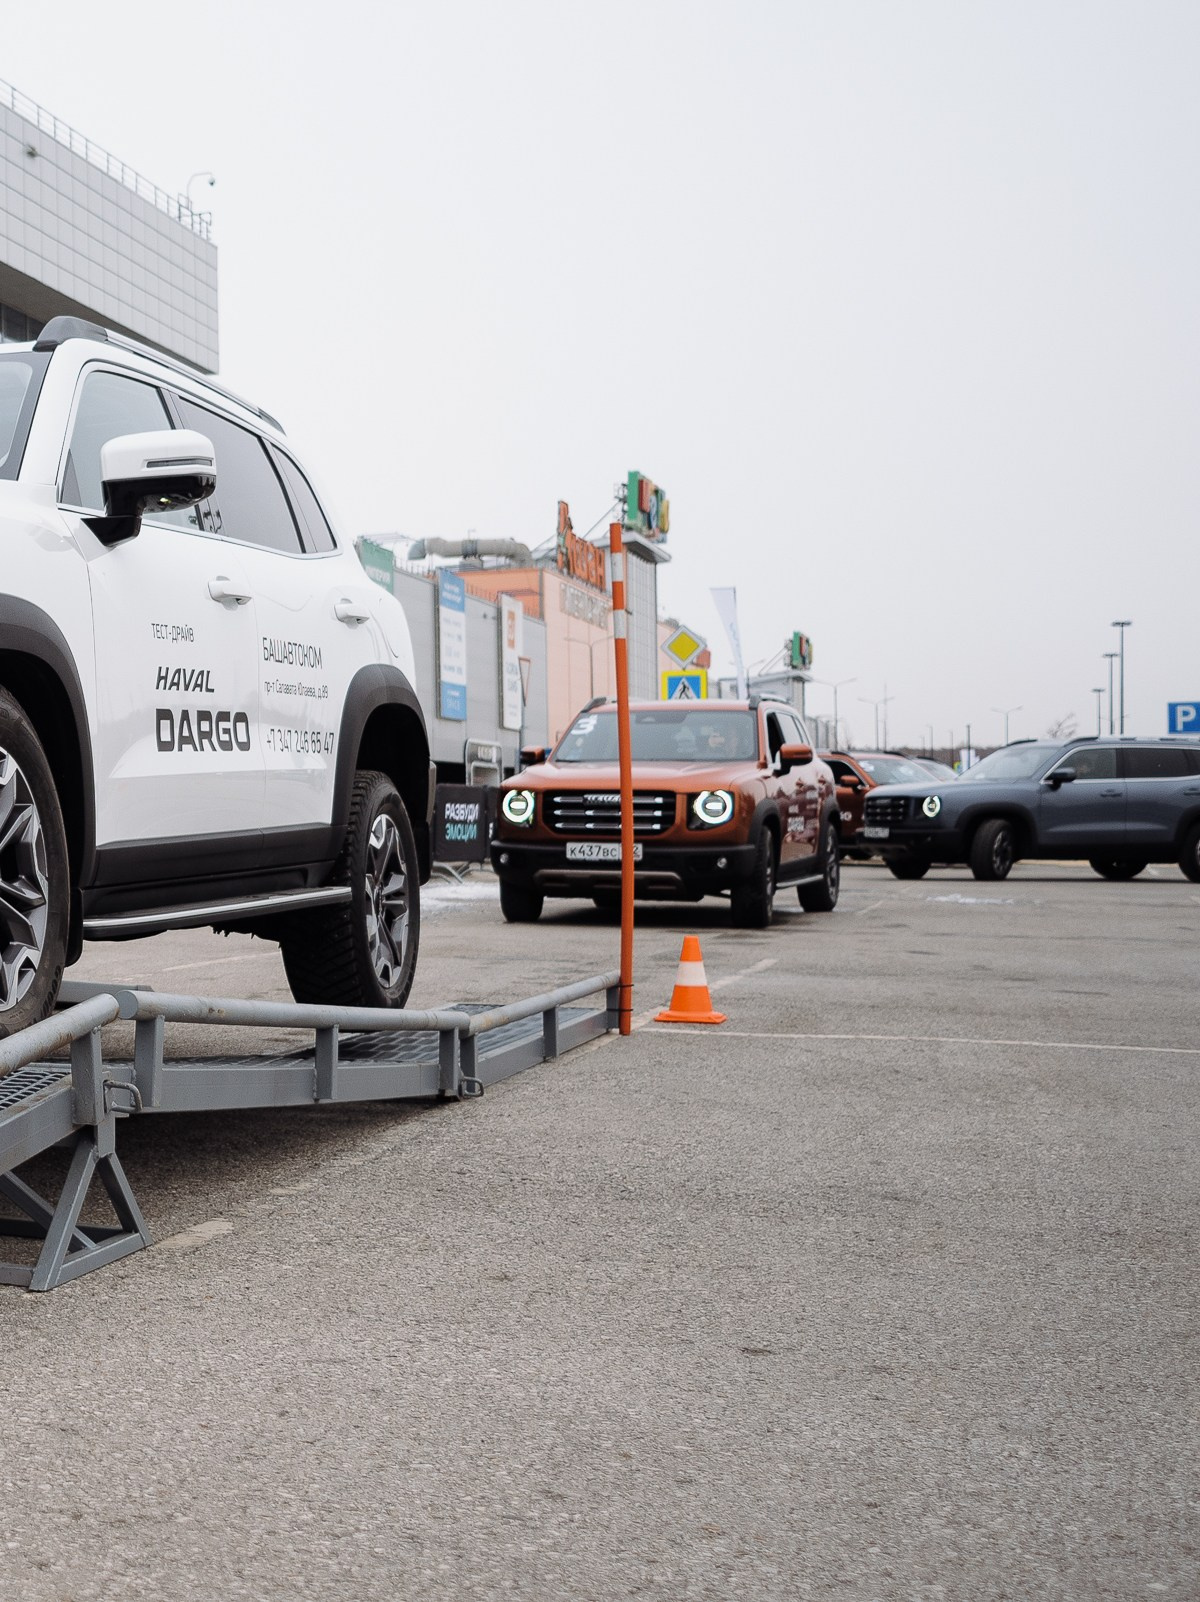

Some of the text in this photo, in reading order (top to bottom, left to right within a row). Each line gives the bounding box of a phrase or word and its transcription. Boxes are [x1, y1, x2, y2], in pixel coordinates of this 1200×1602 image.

[151, 623, 195, 643] ТЕСТ-ДРАЙВ
[262, 637, 323, 669] БАШАВТОКОМ
[155, 666, 215, 693] HAVAL
[155, 708, 251, 752] DARGO
[1176, 705, 1196, 731] P
[278, 729, 293, 752] 347
[323, 732, 335, 755] 47
[444, 803, 480, 823] РАЗБУДИ
[444, 823, 478, 842] ЭМОЦИИ
